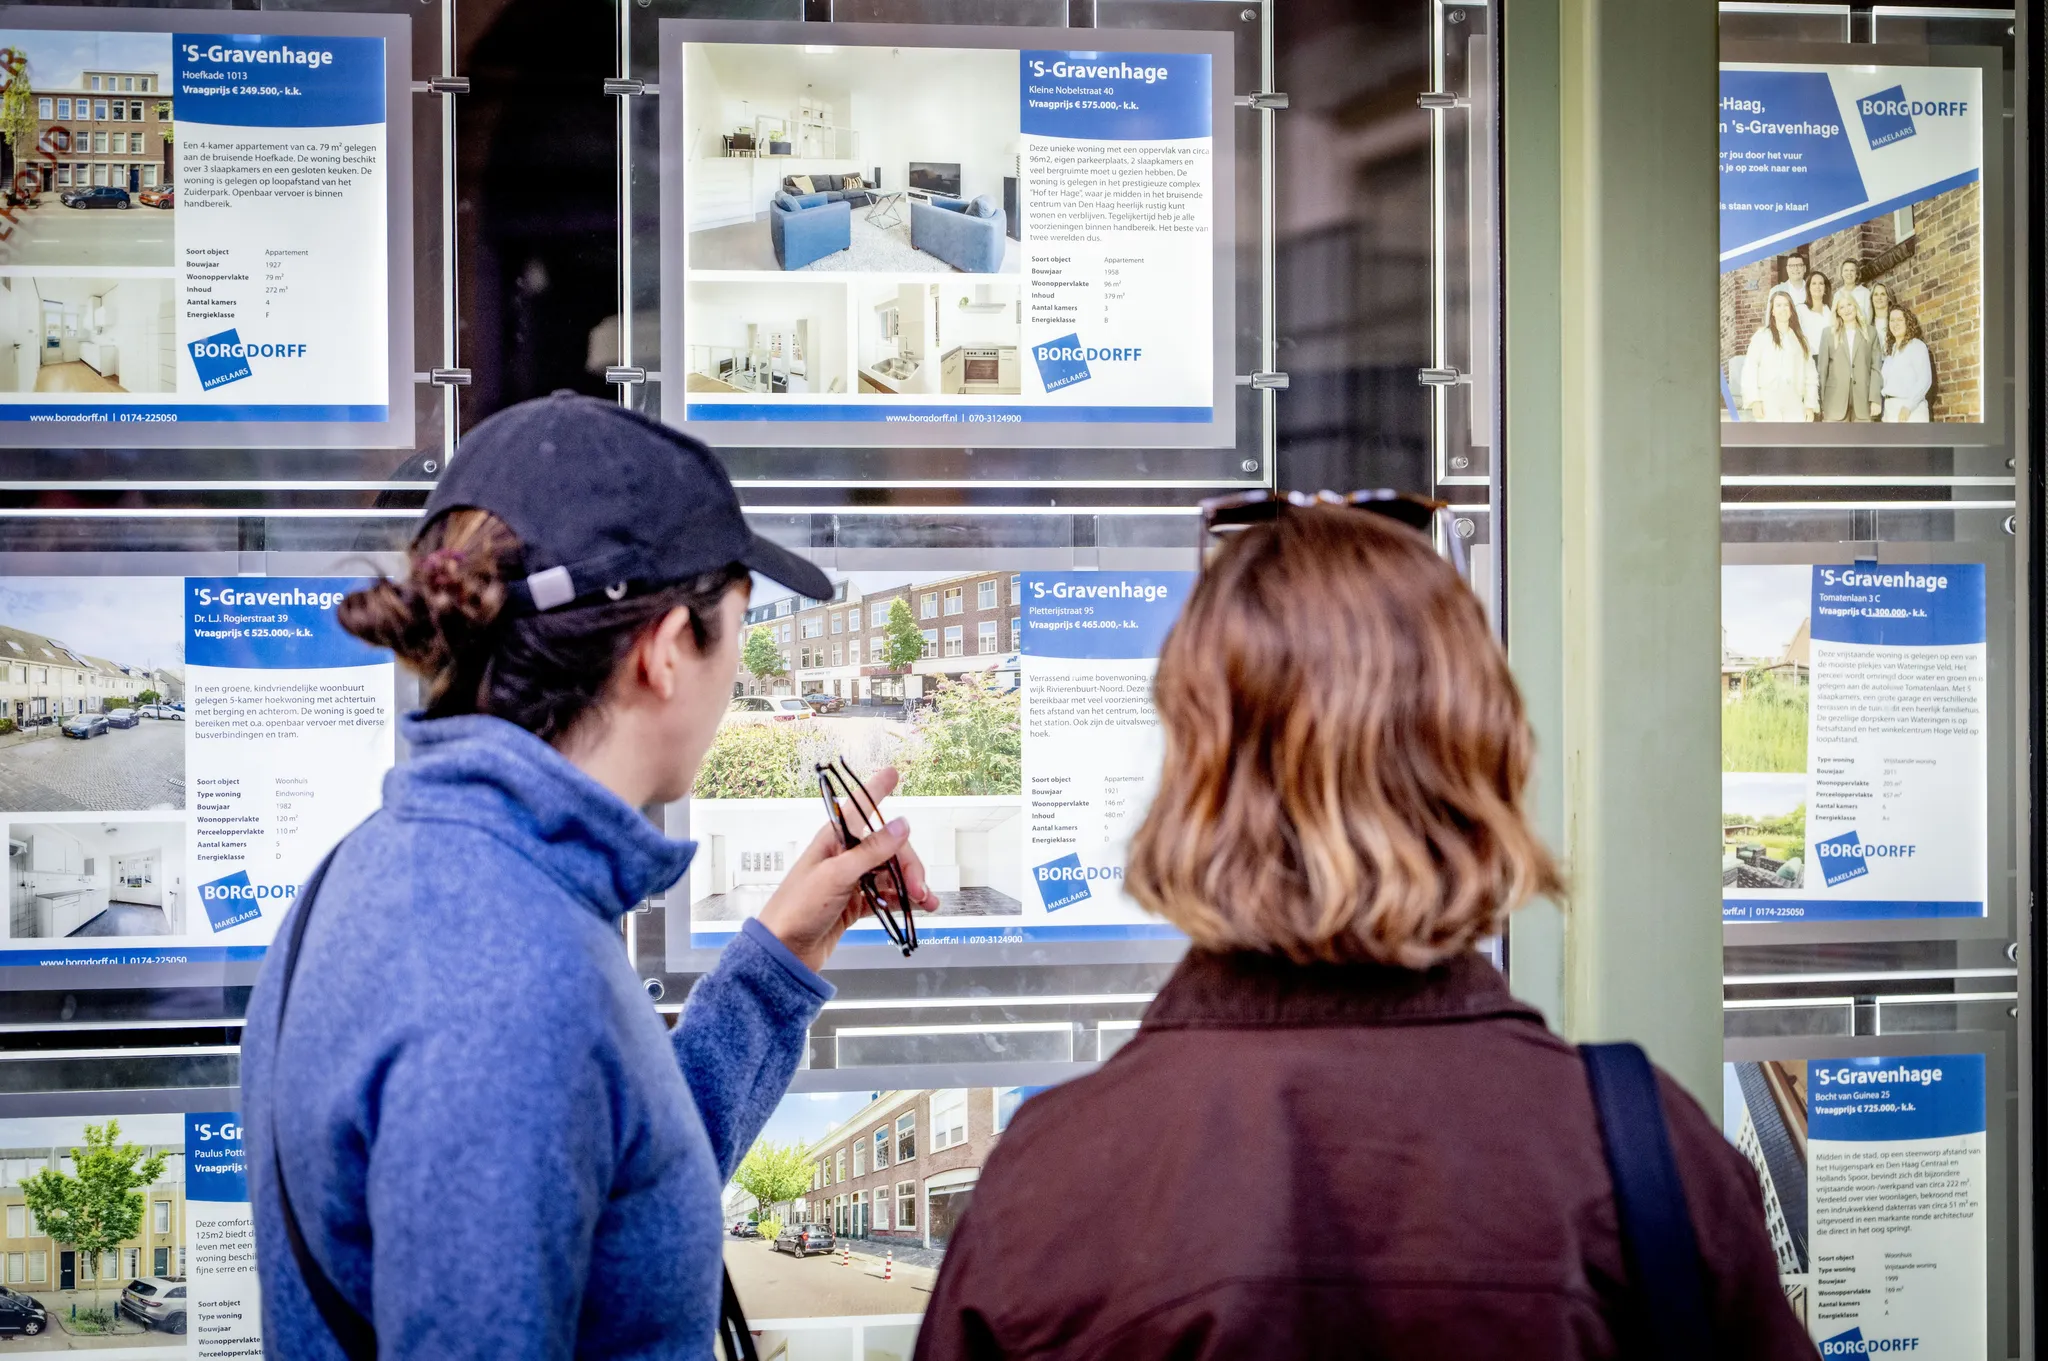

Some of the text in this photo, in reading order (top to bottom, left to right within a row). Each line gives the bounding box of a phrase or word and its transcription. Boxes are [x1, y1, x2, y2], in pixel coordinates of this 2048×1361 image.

[182, 44, 333, 69] 'S-Gravenhage
[182, 70, 248, 80] Hoefkade 1013
[1029, 60, 1168, 84] 'S-Gravenhage
[182, 85, 302, 96] Vraagprijs € 249.500,- k.k.
[1029, 85, 1114, 95] Kleine Nobelstraat 40
[1029, 100, 1139, 110] Vraagprijs € 575.000,- k.k.
[1862, 100, 1968, 116] BORGDORFF
[1732, 120, 1839, 138] 's-Gravenhage
[1871, 126, 1913, 147] MAKELAARS
[183, 141, 198, 150] Een
[200, 142, 234, 150] 4-kamer
[236, 144, 288, 152] appartement
[344, 144, 376, 154] gelegen
[1030, 144, 1049, 152] Deze
[1050, 145, 1076, 153] unieke
[1076, 145, 1105, 155] woning
[1138, 146, 1176, 155] oppervlak
[212, 153, 253, 162] bruisende
[255, 154, 296, 162] Hoefkade.
[297, 154, 309, 162] De
[310, 155, 341, 165] woning
[342, 155, 376, 163] beschikt
[1729, 150, 1743, 161] jou
[1745, 151, 1766, 159] door
[1767, 151, 1781, 160] het
[1725, 163, 1734, 174] je
[1735, 165, 1747, 174] op
[1748, 164, 1769, 172] zoek
[1728, 202, 1752, 210] staan
[1775, 202, 1784, 213] je
[1785, 203, 1809, 211] klaar!
[206, 248, 229, 256] object
[186, 261, 220, 269] Bouwjaar
[187, 312, 235, 320] Energieklasse
[194, 343, 307, 358] BORGDORFF
[1038, 347, 1142, 361] BORGDORFF
[204, 368, 248, 388] MAKELAARS
[1047, 371, 1088, 389] MAKELAARS
[120, 414, 177, 422] 0174-225050
[1821, 569, 1948, 593] 'S-Gravenhage
[1030, 581, 1168, 602] 'S-Gravenhage
[194, 588, 344, 610] 'S-Gravenhage
[1819, 593, 1880, 603] Tomatenlaan 3 C
[1029, 607, 1094, 617] Pletterijstraat 95
[1819, 607, 1859, 617] Vraagprijs
[1867, 608, 1911, 617] 1.300.000,-
[194, 614, 288, 625] Dr. L.J. Rogierstraat 39
[1029, 621, 1073, 631] Vraagprijs
[1082, 620, 1122, 629] 465.000,-
[1123, 620, 1139, 628] k.k.
[194, 628, 313, 640] Vraagprijs € 525.000,- k.k.
[221, 686, 252, 694] groene,
[254, 684, 318, 694] kindvriendelijke
[1030, 685, 1145, 695] wijk Rivierenbuurt-Noord. Deze
[1820, 844, 1916, 858] BORGDORFF
[1039, 867, 1122, 881] BORGDOR
[1827, 867, 1866, 884] MAKELAARS
[205, 885, 304, 900] BORGDOR
[1047, 890, 1088, 910] MAKELAARS
[214, 909, 258, 929] MAKELAARS
[970, 936, 1022, 944] 070-3124900
[1815, 1065, 1942, 1085] 'S-Gravenhage
[1815, 1092, 1837, 1101] Bocht
[1853, 1091, 1880, 1100] Guinea
[1881, 1090, 1890, 1099] 25
[1815, 1102, 1916, 1115] Vraagprijs € 725.000,- k.k.
[225, 1149, 245, 1157] Pott
[194, 1163, 242, 1174] Vraagprijs
[1886, 1225, 1912, 1234] springt.
[198, 1336, 261, 1346] Woonoppervlakte
[1824, 1338, 1919, 1355] BORGDORFF
